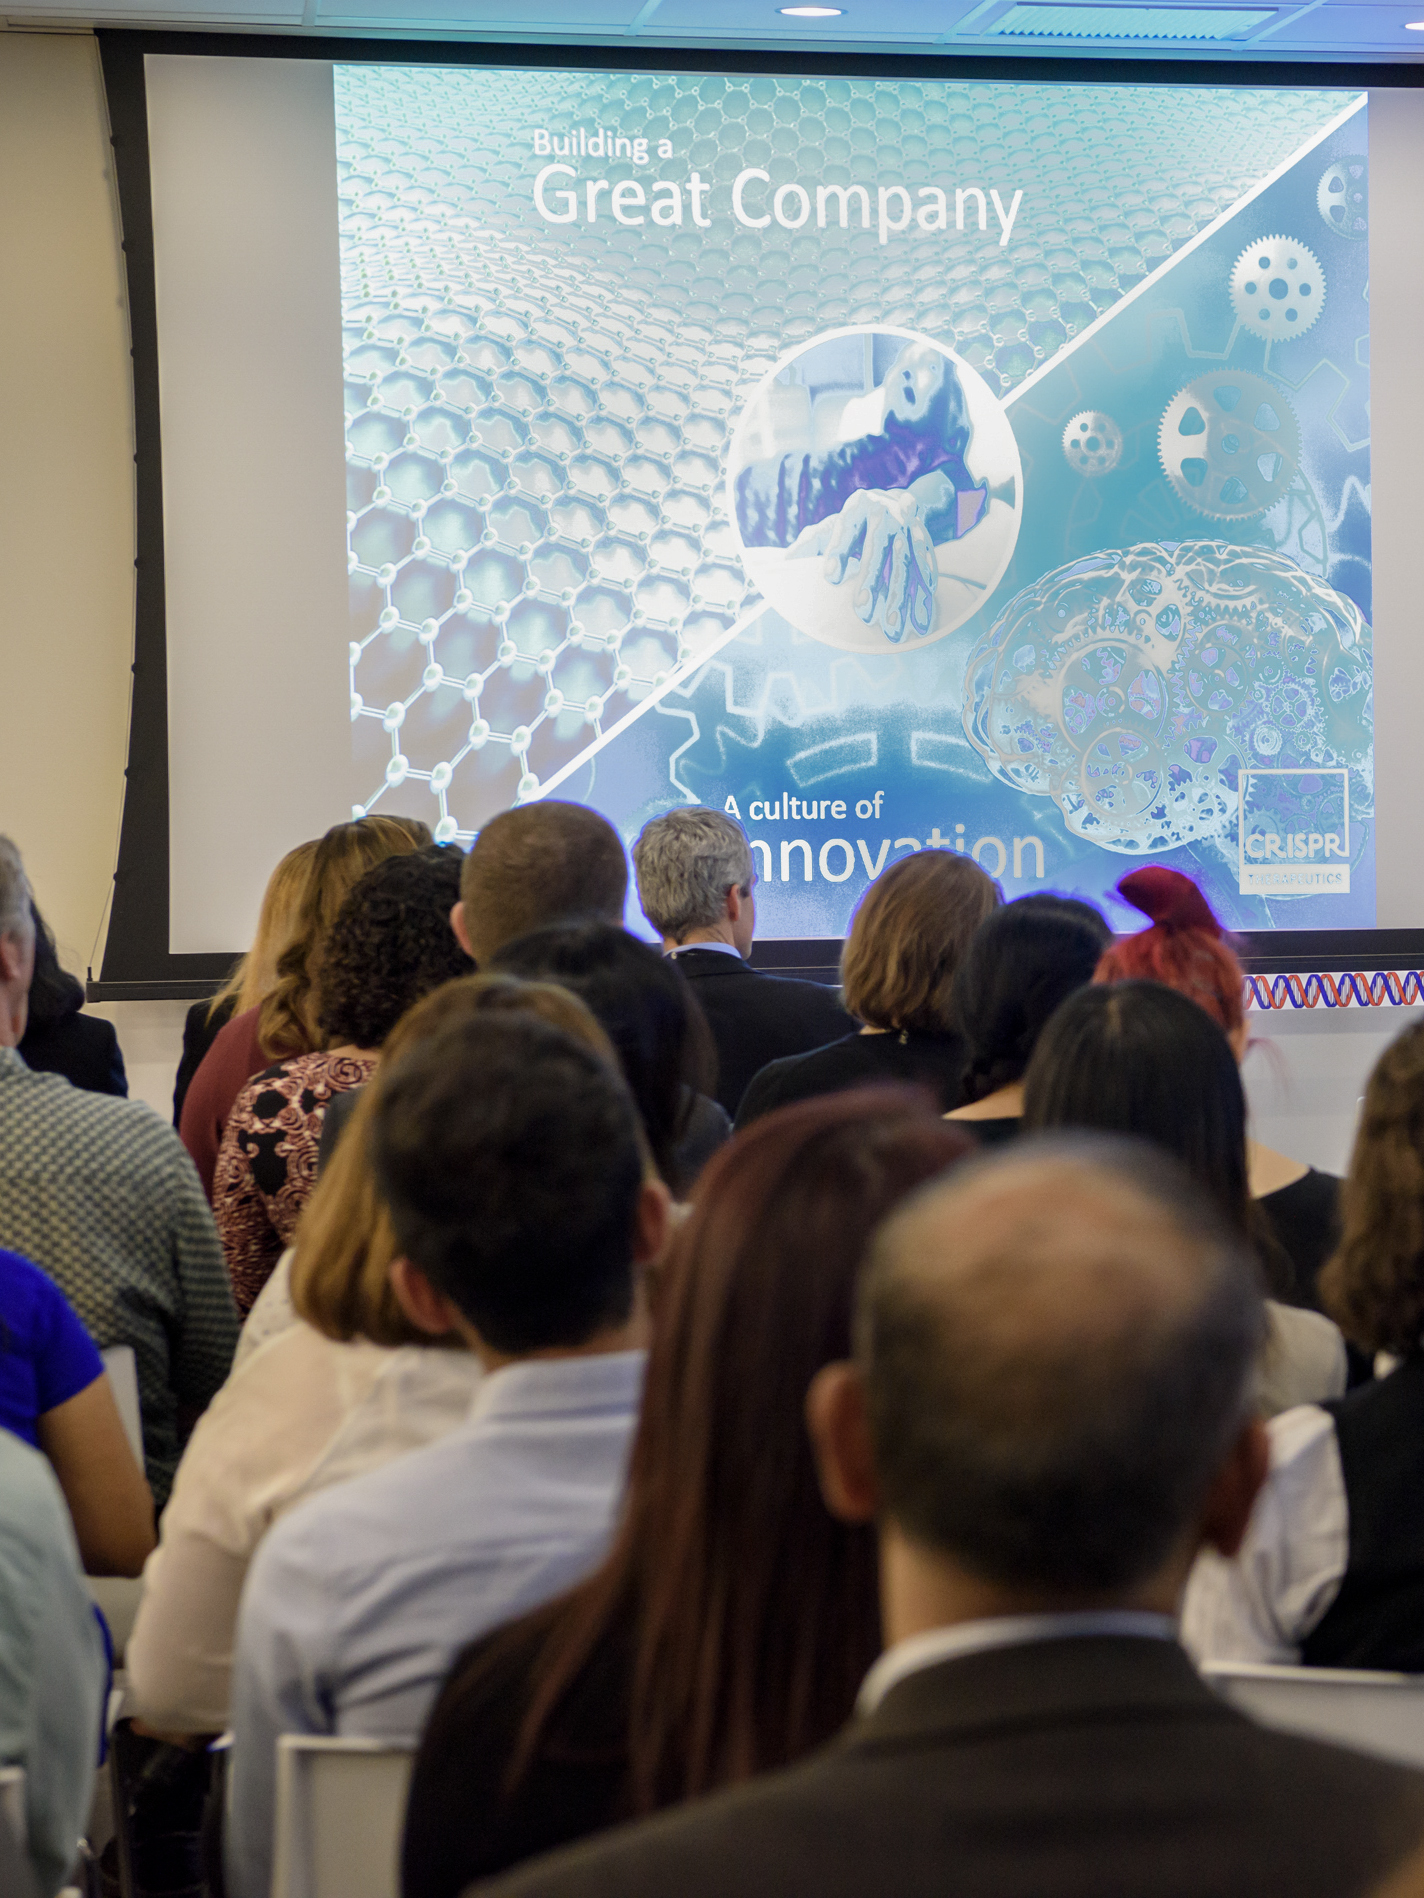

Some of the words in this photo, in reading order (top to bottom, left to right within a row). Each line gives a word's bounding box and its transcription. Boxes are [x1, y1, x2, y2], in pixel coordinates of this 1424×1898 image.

[533, 127, 650, 165] Building
[657, 138, 673, 158] a
[533, 163, 711, 227] Great
[731, 168, 1023, 246] Company
[724, 795, 741, 819] A
[749, 792, 847, 820] culture
[855, 790, 884, 819] of
[750, 824, 1045, 882] nnovion
[1245, 833, 1349, 858] CRISPR
[1248, 873, 1342, 885] THERAPEUTICS
